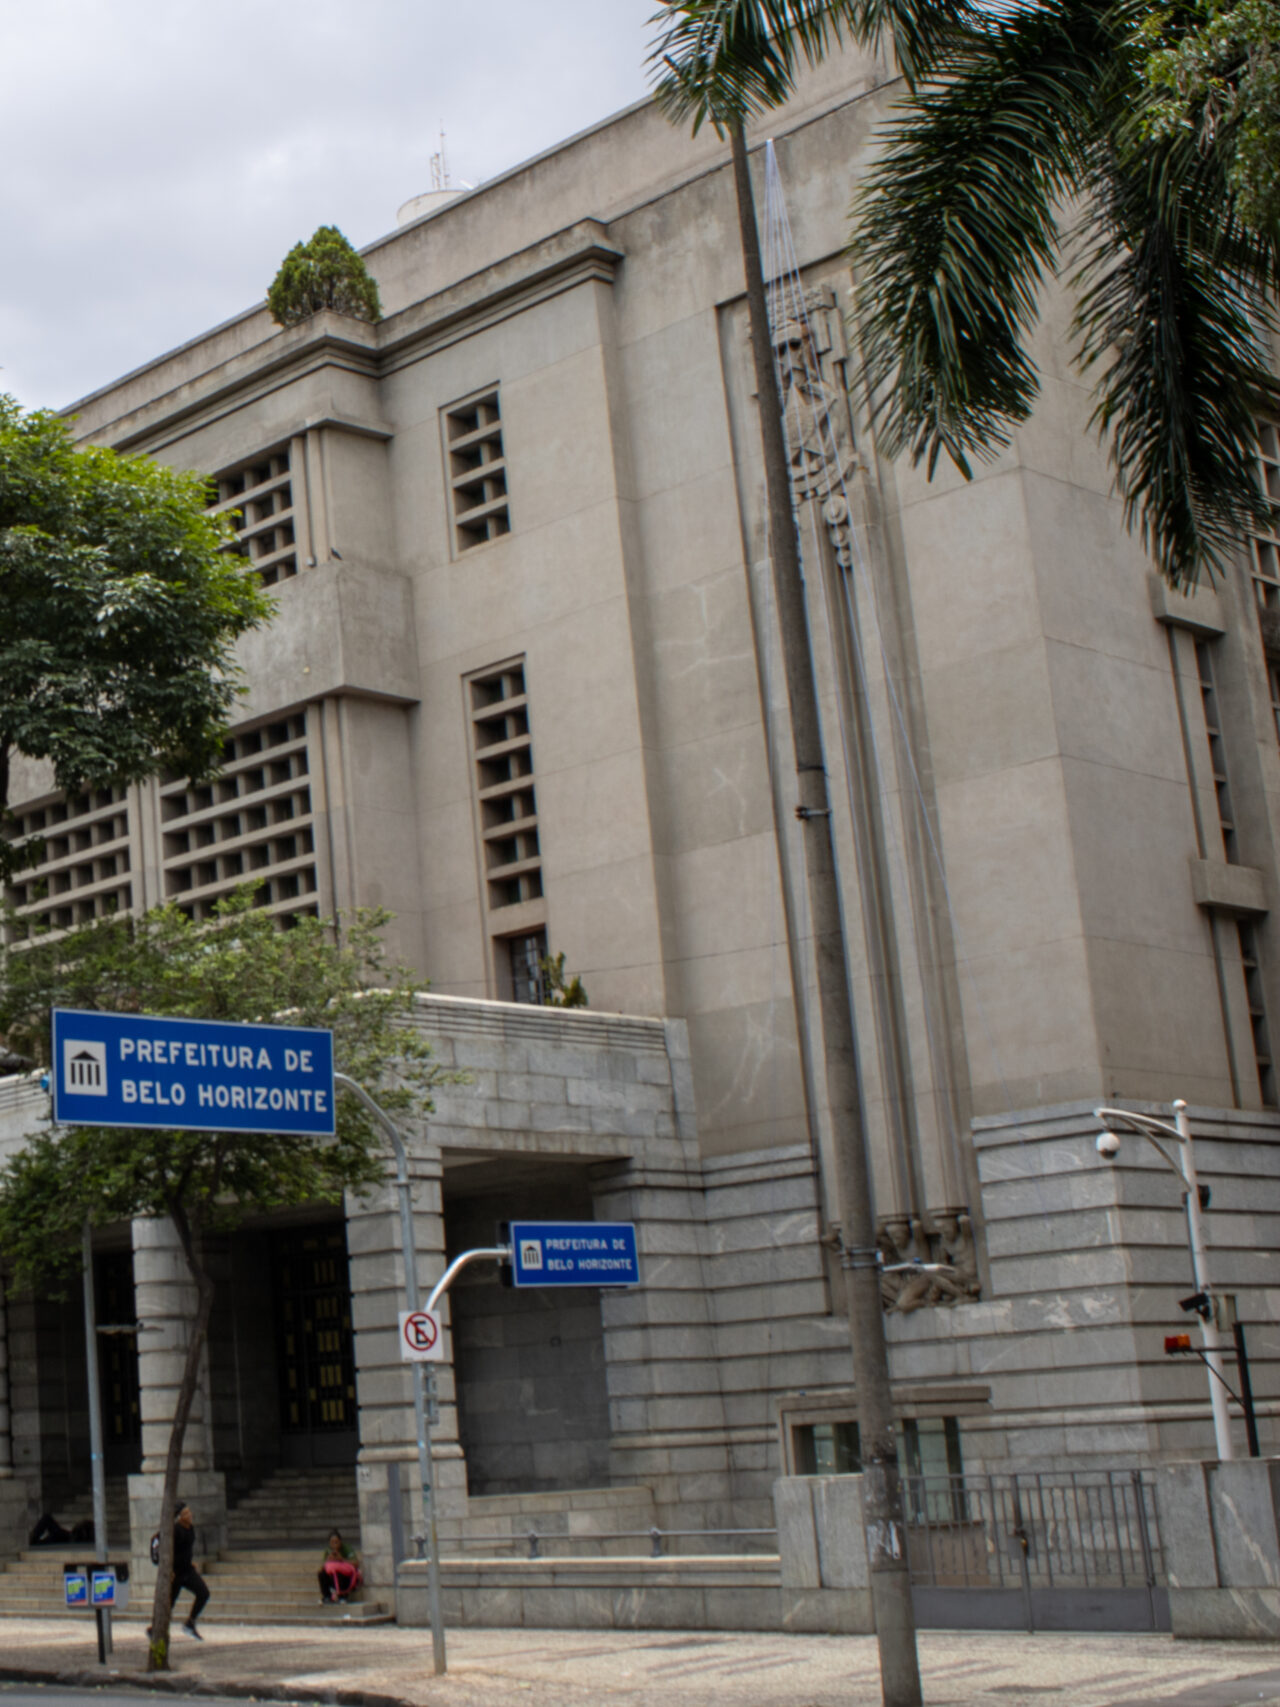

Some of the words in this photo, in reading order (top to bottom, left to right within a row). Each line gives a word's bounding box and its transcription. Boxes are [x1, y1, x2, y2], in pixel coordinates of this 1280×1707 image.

[120, 1038, 273, 1070] PREFEITURA
[284, 1049, 314, 1073] DE
[121, 1080, 186, 1106] BELO
[198, 1084, 327, 1112] HORIZONTE
[546, 1239, 608, 1250] PREFEITURA
[612, 1239, 626, 1250] DE
[547, 1259, 574, 1270] BELO
[578, 1259, 632, 1270] HORIZONTE
[415, 1320, 429, 1344] E
